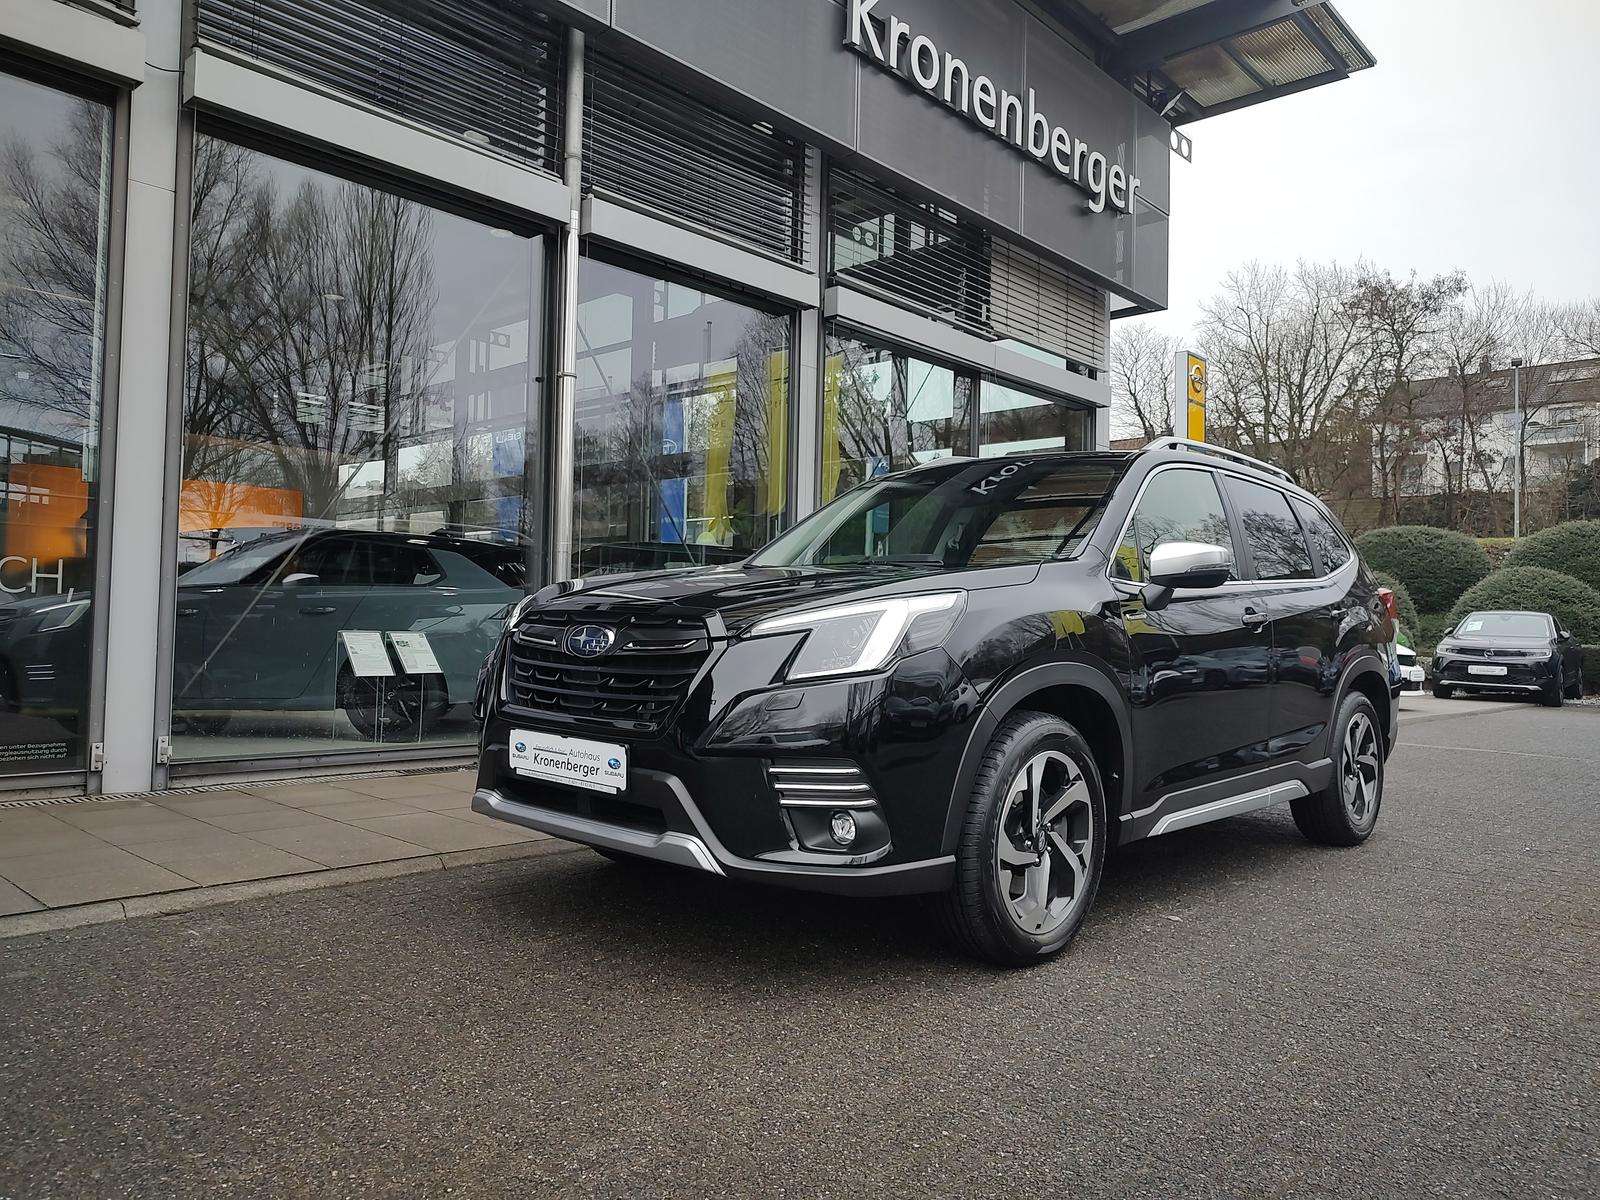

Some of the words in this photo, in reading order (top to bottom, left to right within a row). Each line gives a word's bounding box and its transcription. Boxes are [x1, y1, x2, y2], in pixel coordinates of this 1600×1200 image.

[847, 0, 1141, 213] Kronenberger
[533, 752, 601, 777] Kronenberger
[568, 748, 601, 762] Autohaus
